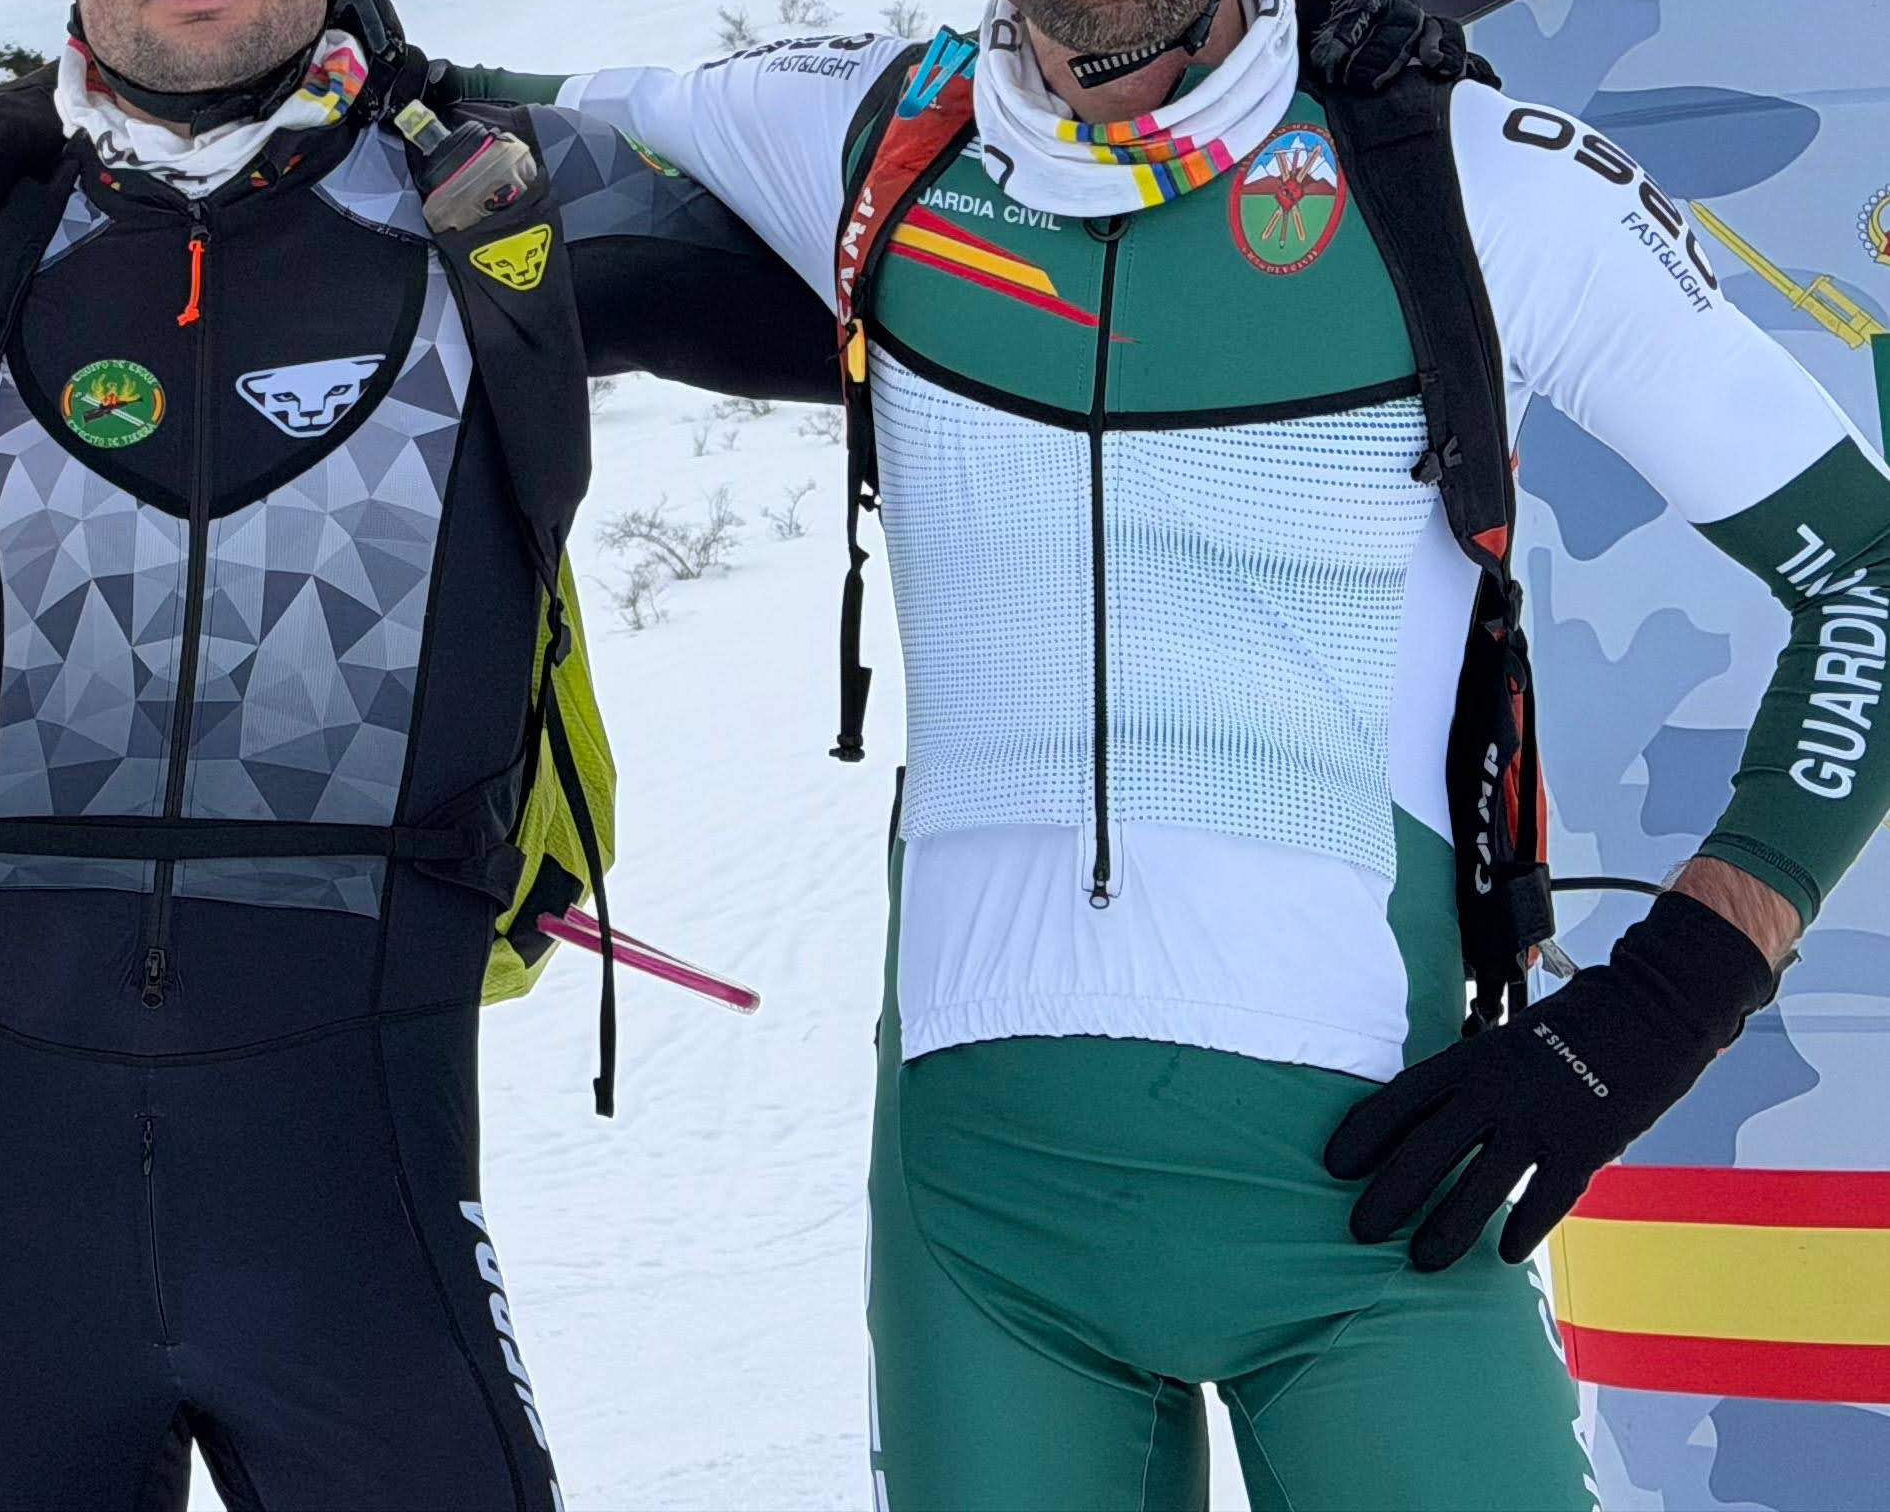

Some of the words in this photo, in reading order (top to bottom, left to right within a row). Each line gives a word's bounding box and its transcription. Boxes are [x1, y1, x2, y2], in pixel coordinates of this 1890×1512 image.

[766, 54, 860, 81] FAST&LIGHT
[838, 186, 876, 327] CAMP
[917, 187, 995, 219] UARDIA
[1003, 204, 1062, 231] CIVIL
[1620, 210, 1713, 313] FAST&LIGHT
[1789, 586, 1890, 799] GUARDIA
[1474, 742, 1499, 895] CAMP
[1546, 1034, 1609, 1098] SIMOND
